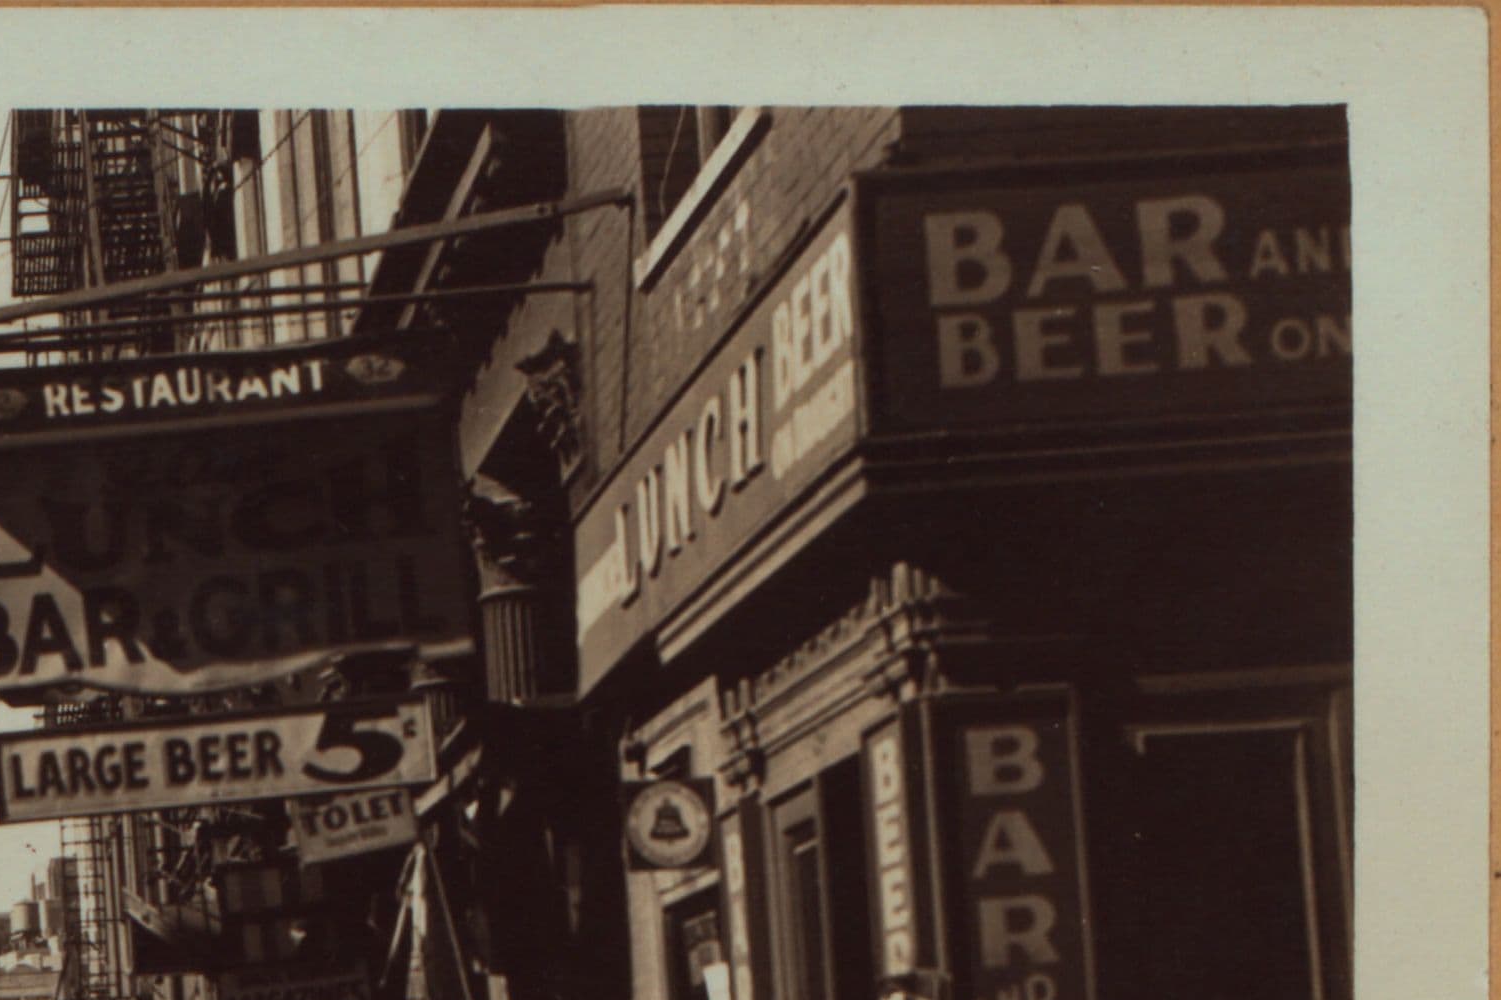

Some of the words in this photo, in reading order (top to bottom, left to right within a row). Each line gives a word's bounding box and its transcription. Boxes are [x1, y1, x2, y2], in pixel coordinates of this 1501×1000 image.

[923, 194, 1229, 308] BAR
[772, 231, 853, 414] BEER
[935, 291, 1253, 390] BEER
[42, 359, 330, 418] RESTAURANT
[614, 350, 763, 609] LUNCH
[189, 553, 454, 659] GRILL
[10, 742, 151, 799] LARGE
[166, 729, 285, 787] BEER
[872, 736, 912, 977] BEER
[963, 725, 1061, 969] BAR
